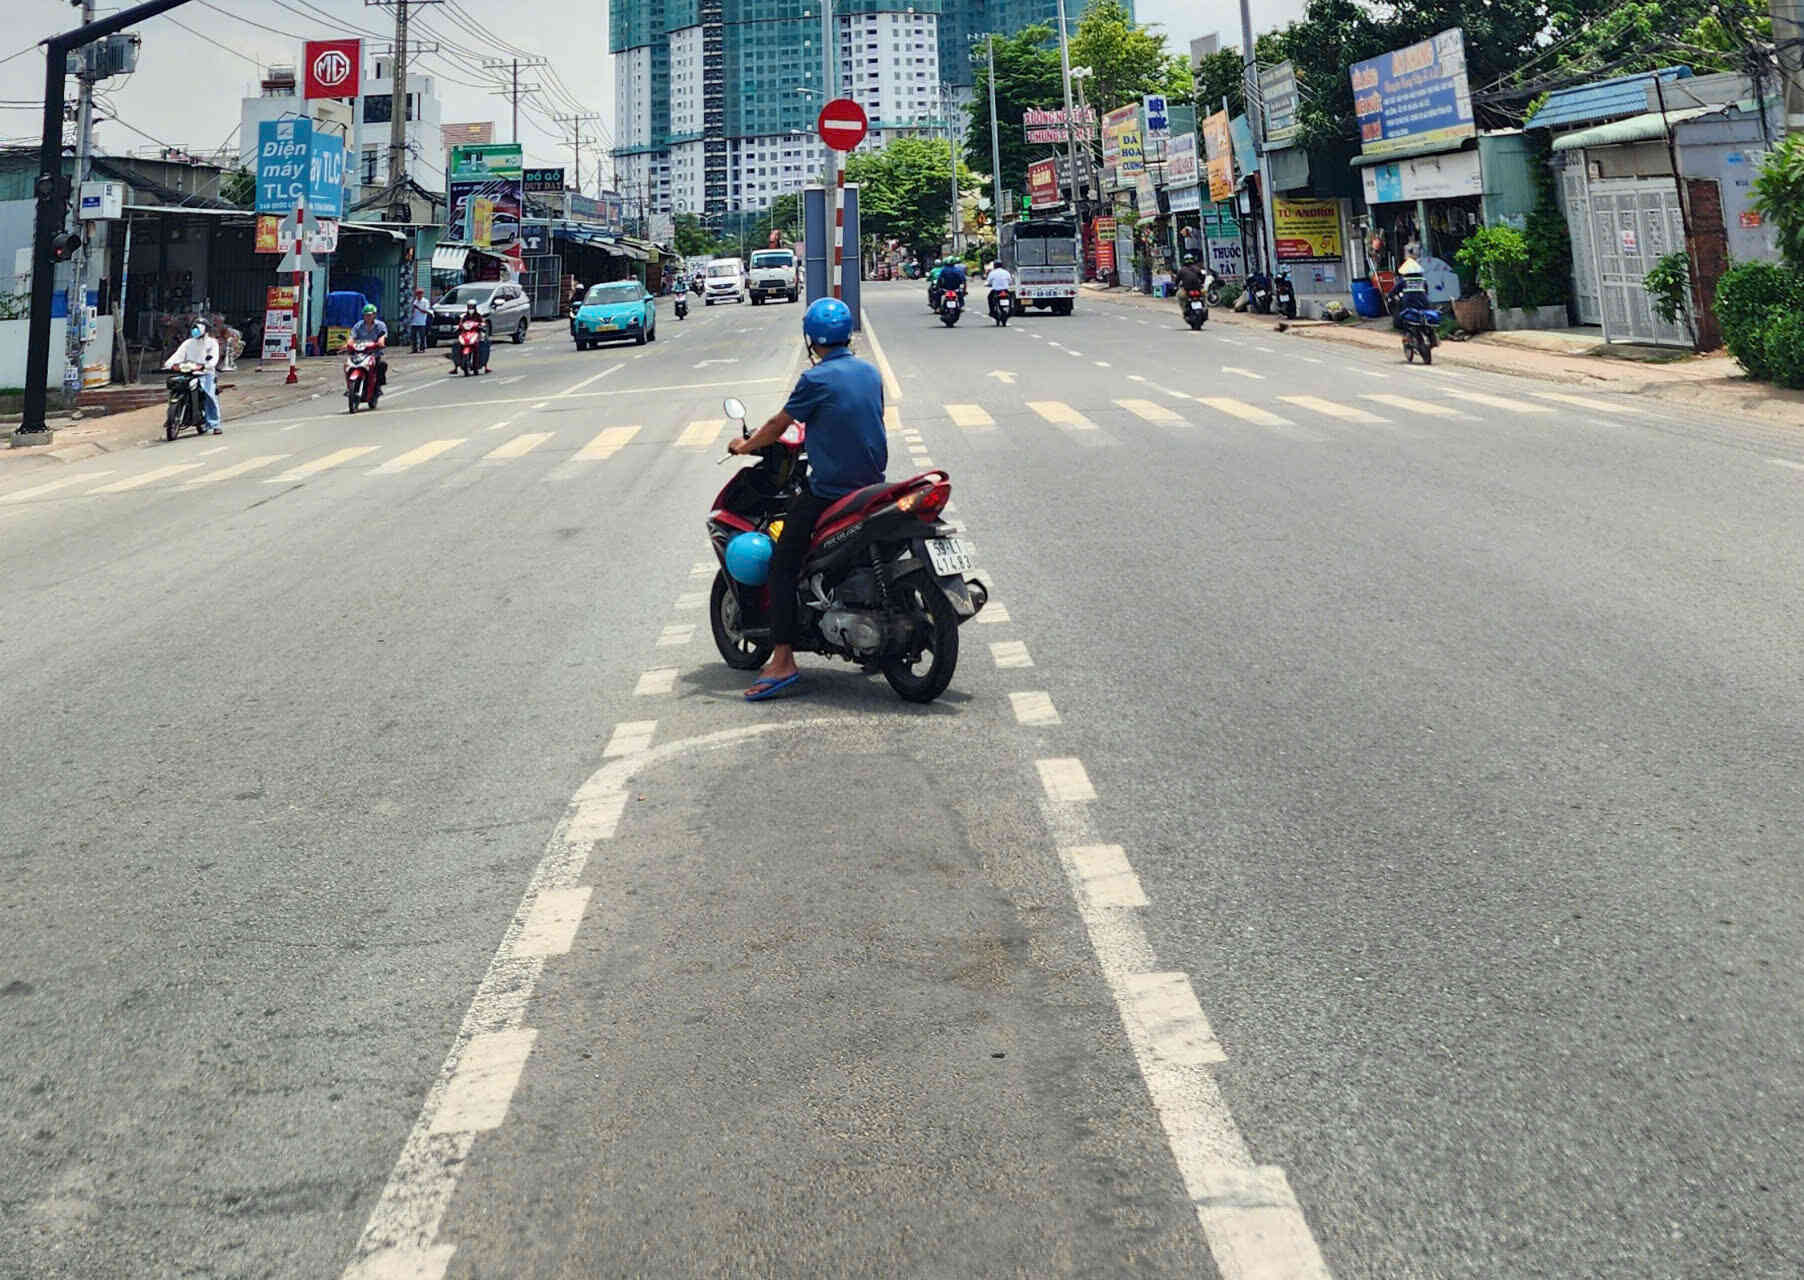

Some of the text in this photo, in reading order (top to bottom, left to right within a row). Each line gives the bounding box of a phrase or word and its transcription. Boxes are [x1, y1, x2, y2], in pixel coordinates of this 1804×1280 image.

[316, 53, 348, 83] MG
[261, 138, 307, 160] Điện
[1121, 147, 1142, 157] HOA
[262, 160, 305, 180] máy
[322, 150, 341, 185] TLC
[263, 183, 303, 199] TLC
[1213, 241, 1242, 260] THUỐC
